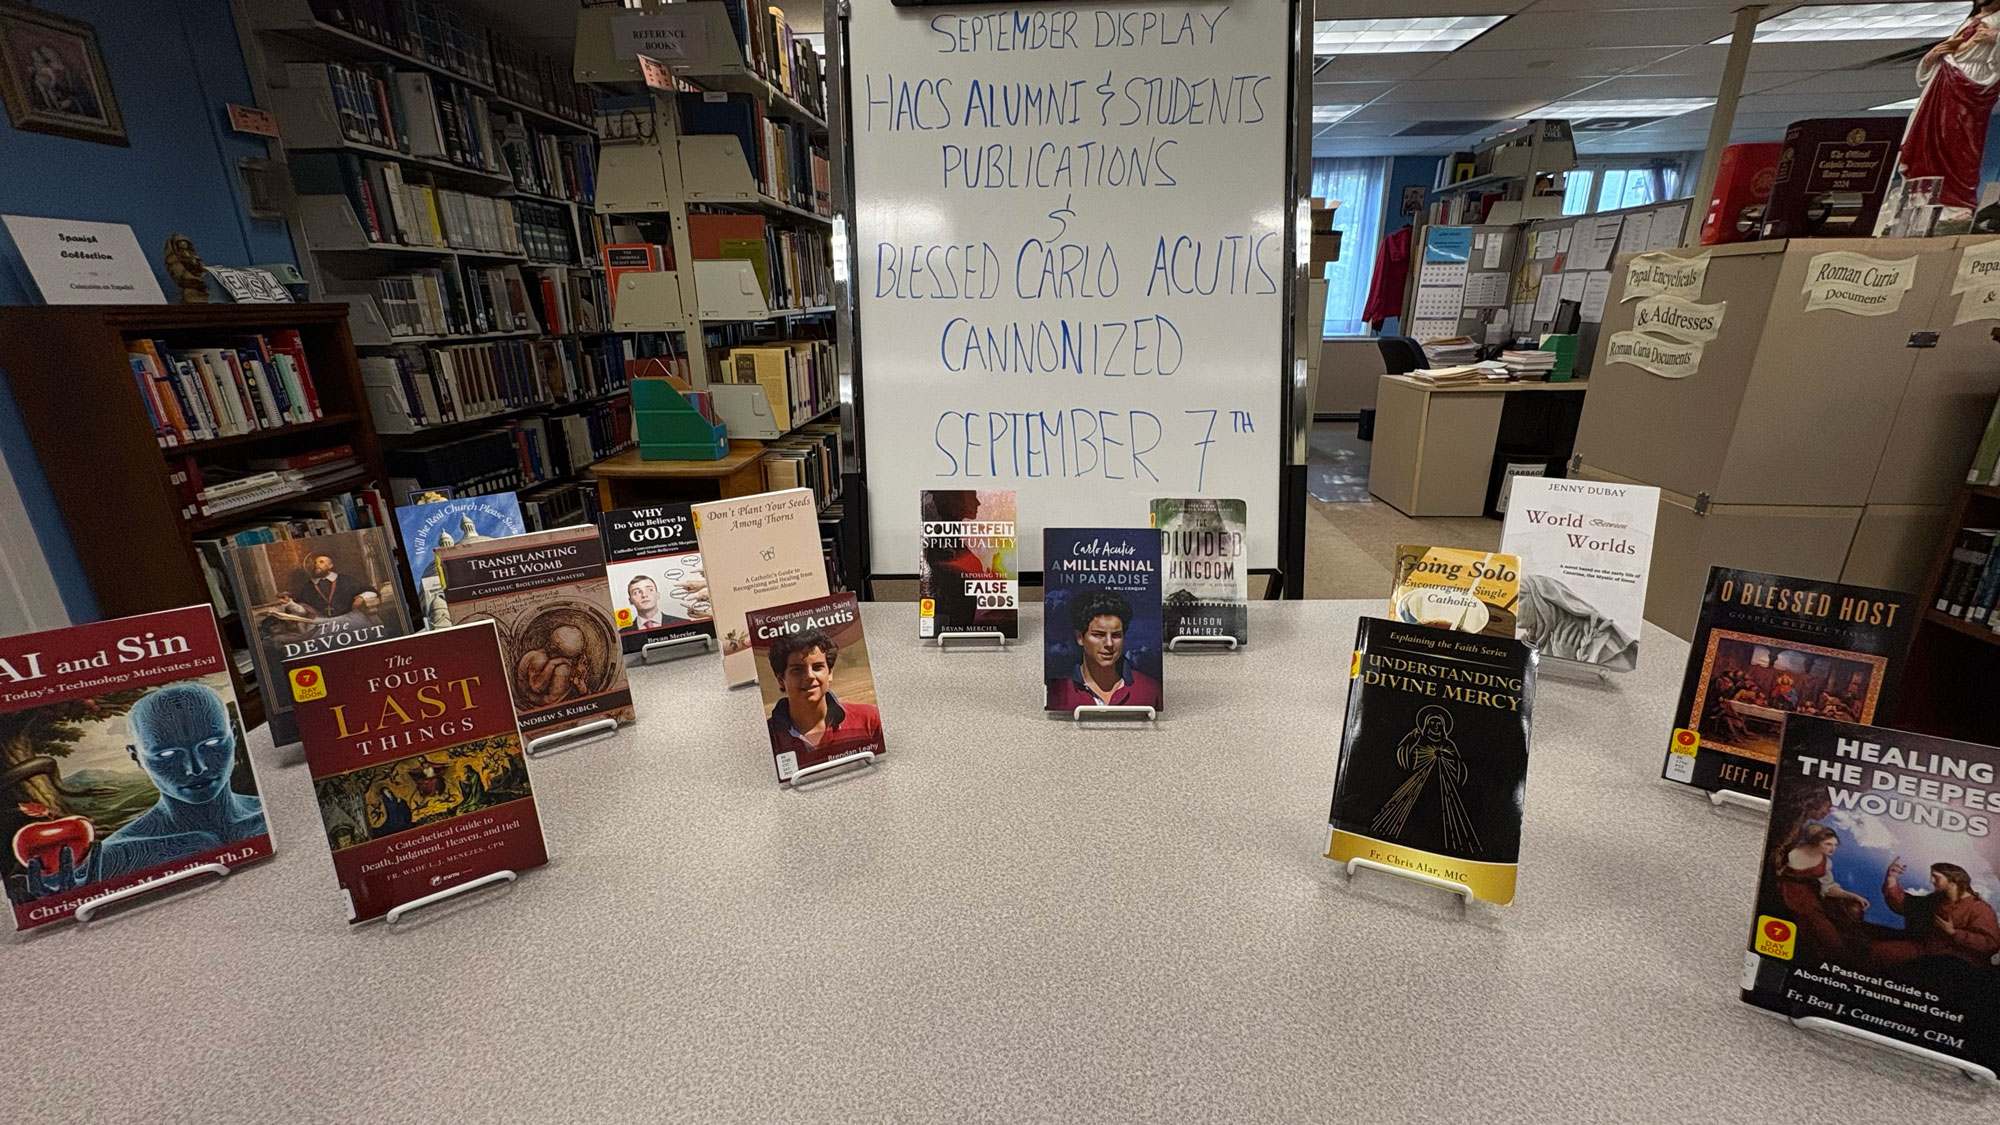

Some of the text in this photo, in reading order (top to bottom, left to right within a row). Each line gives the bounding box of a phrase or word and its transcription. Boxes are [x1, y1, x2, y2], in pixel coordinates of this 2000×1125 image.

[632, 30, 687, 40] REFERENCE
[930, 6, 1230, 53] SEPTEMBER DISPLAY
[645, 41, 677, 50] BOOKS
[866, 70, 1271, 132] HACS ALUMNI & STUDENTS
[942, 136, 1179, 188] PUBLICATIONS
[1832, 180, 1850, 188] 2024
[58, 233, 98, 244] Spanish
[61, 251, 113, 260] Collection
[876, 232, 1278, 299] BLESSED CARLO ACUTIS
[1628, 265, 1697, 290] Papal Encyclicals
[1815, 263, 1900, 287] Roman Curia
[1970, 260, 2000, 276] Papa
[1825, 288, 1887, 304] Documents
[1983, 290, 1997, 304] &
[1637, 306, 1714, 330] & Addresses
[941, 314, 1183, 377] CANNONIZED
[1609, 341, 1692, 365] Roman Curia Documents
[935, 408, 1162, 483] SEPTEMBER
[1548, 483, 1627, 497] JENNY DUBAY
[427, 511, 444, 526] Real
[444, 502, 478, 515] Church
[479, 504, 505, 520] Please
[631, 507, 663, 520] WHY
[707, 496, 811, 521] Don't Plant Your Seeds
[1526, 509, 1628, 530] World Between
[419, 523, 430, 537] the
[614, 515, 687, 530] Do You Believe In
[730, 512, 794, 531] Among Thorns
[924, 523, 1014, 535] COUNTERFEIT
[629, 523, 684, 543] GOD?
[922, 537, 1017, 549] SPIRITUALITY
[1161, 530, 1242, 557] DIVIDED
[1566, 533, 1636, 555] Worlds
[416, 536, 426, 556] Will
[1072, 538, 1136, 557] Carlo Acutis
[468, 546, 577, 571] TRANSPLANTING
[489, 559, 563, 579] THE WOMB
[1051, 559, 1154, 572] A MILLENNIAL
[1399, 554, 1516, 582] Going Solo
[1060, 574, 1149, 584] IN PARADISE
[1169, 561, 1235, 580] KINGDOM
[479, 584, 514, 595] CATHOLIC
[515, 578, 555, 589] BIOETHICAL
[556, 571, 585, 582] ANALYSIS
[965, 581, 1008, 594] FALSE
[1402, 578, 1507, 600] Encouraging Single
[977, 595, 1014, 607] GODS
[1427, 593, 1478, 608] Catholics
[1720, 580, 1900, 628] O BLESSED HOST
[755, 600, 851, 626] In Conversation with Saint
[1180, 616, 1222, 625] ALLISON
[1729, 612, 1775, 624] GOSPEL
[317, 621, 349, 635] The
[758, 611, 854, 640] Carlo Acutis
[1179, 627, 1224, 636] RAMIREZ
[284, 625, 385, 657] DEVOUT
[1389, 631, 1508, 658] Explaining the Faith Series
[0, 632, 192, 685] AI and Sin
[385, 655, 413, 669] The
[1, 655, 217, 703] Today's Technology Motivates Evil
[367, 666, 438, 693] FOUR
[1368, 653, 1523, 692] UNDERSTANDING
[1364, 670, 1523, 712] DIVINE MERCY
[328, 676, 481, 740] LAST
[518, 702, 599, 728] ANDREW S. KUBICK
[356, 717, 475, 756] THINGS
[827, 742, 879, 761] Brendan Leahy
[1835, 737, 1994, 784] HEALING
[1719, 763, 1774, 791] JEFF PL
[1798, 755, 1863, 785] THE
[1827, 786, 1989, 837] WOUNDS
[361, 819, 520, 873] Death, Judgment, Heaven, and Hell
[385, 816, 493, 854] A Catechetical Guide to
[215, 847, 259, 866] Th.D.
[1369, 849, 1468, 883] Fr. Chris Alar, MIC
[1760, 944, 1789, 958] BOOK
[1764, 940, 1784, 950] DAY
[1819, 962, 1940, 1002] A Pastoral Guide to
[1793, 968, 1966, 1024] Abortion, Trauma and Grief
[1786, 988, 1966, 1050] Fr. Ben J. Cameron, CPM
